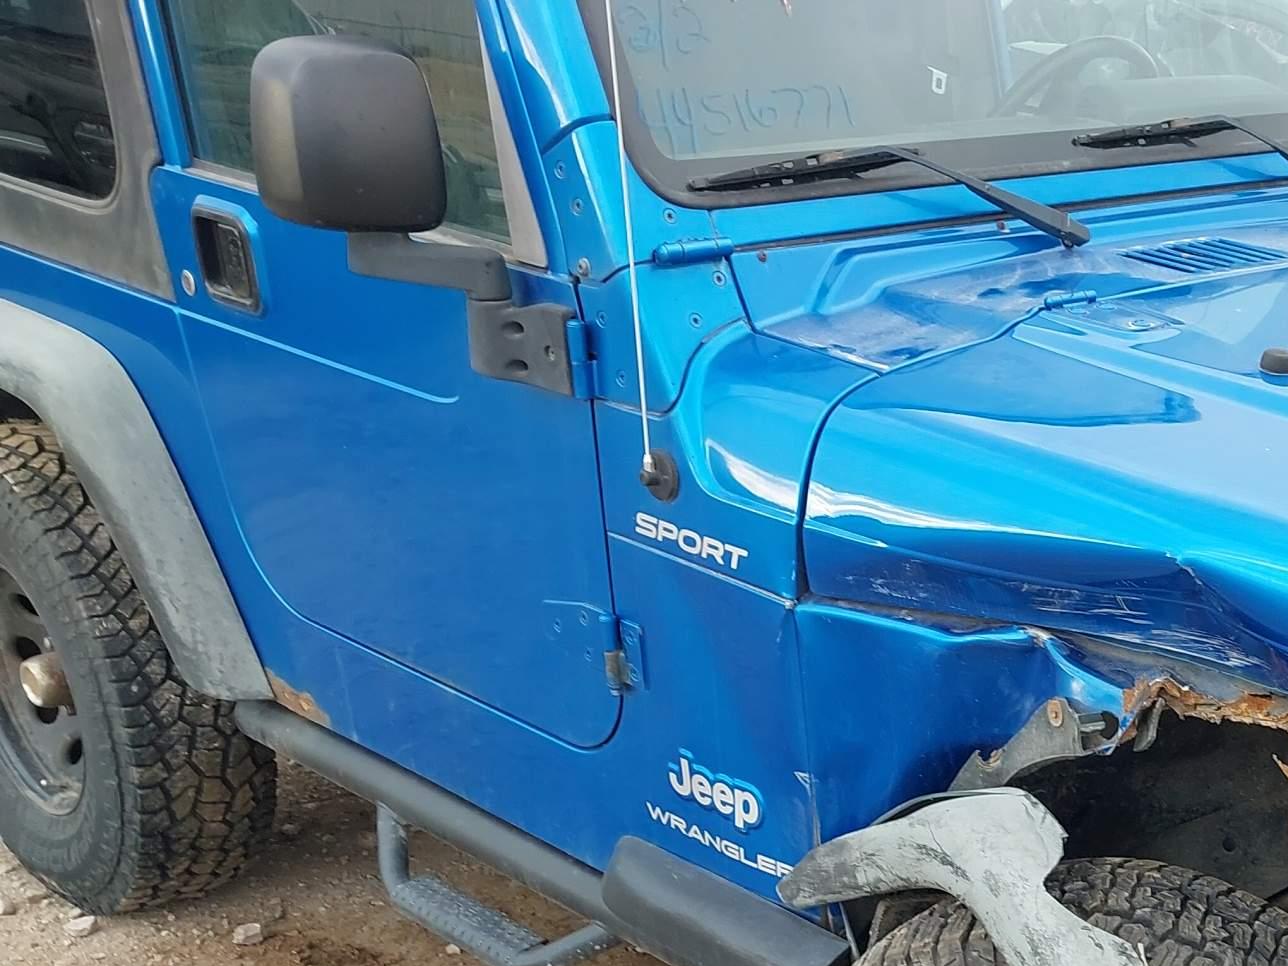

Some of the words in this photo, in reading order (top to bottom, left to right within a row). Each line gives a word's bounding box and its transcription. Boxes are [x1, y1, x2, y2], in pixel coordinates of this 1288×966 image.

[635, 85, 856, 158] 44516771
[634, 511, 749, 570] SPORT
[667, 756, 761, 830] Jeep
